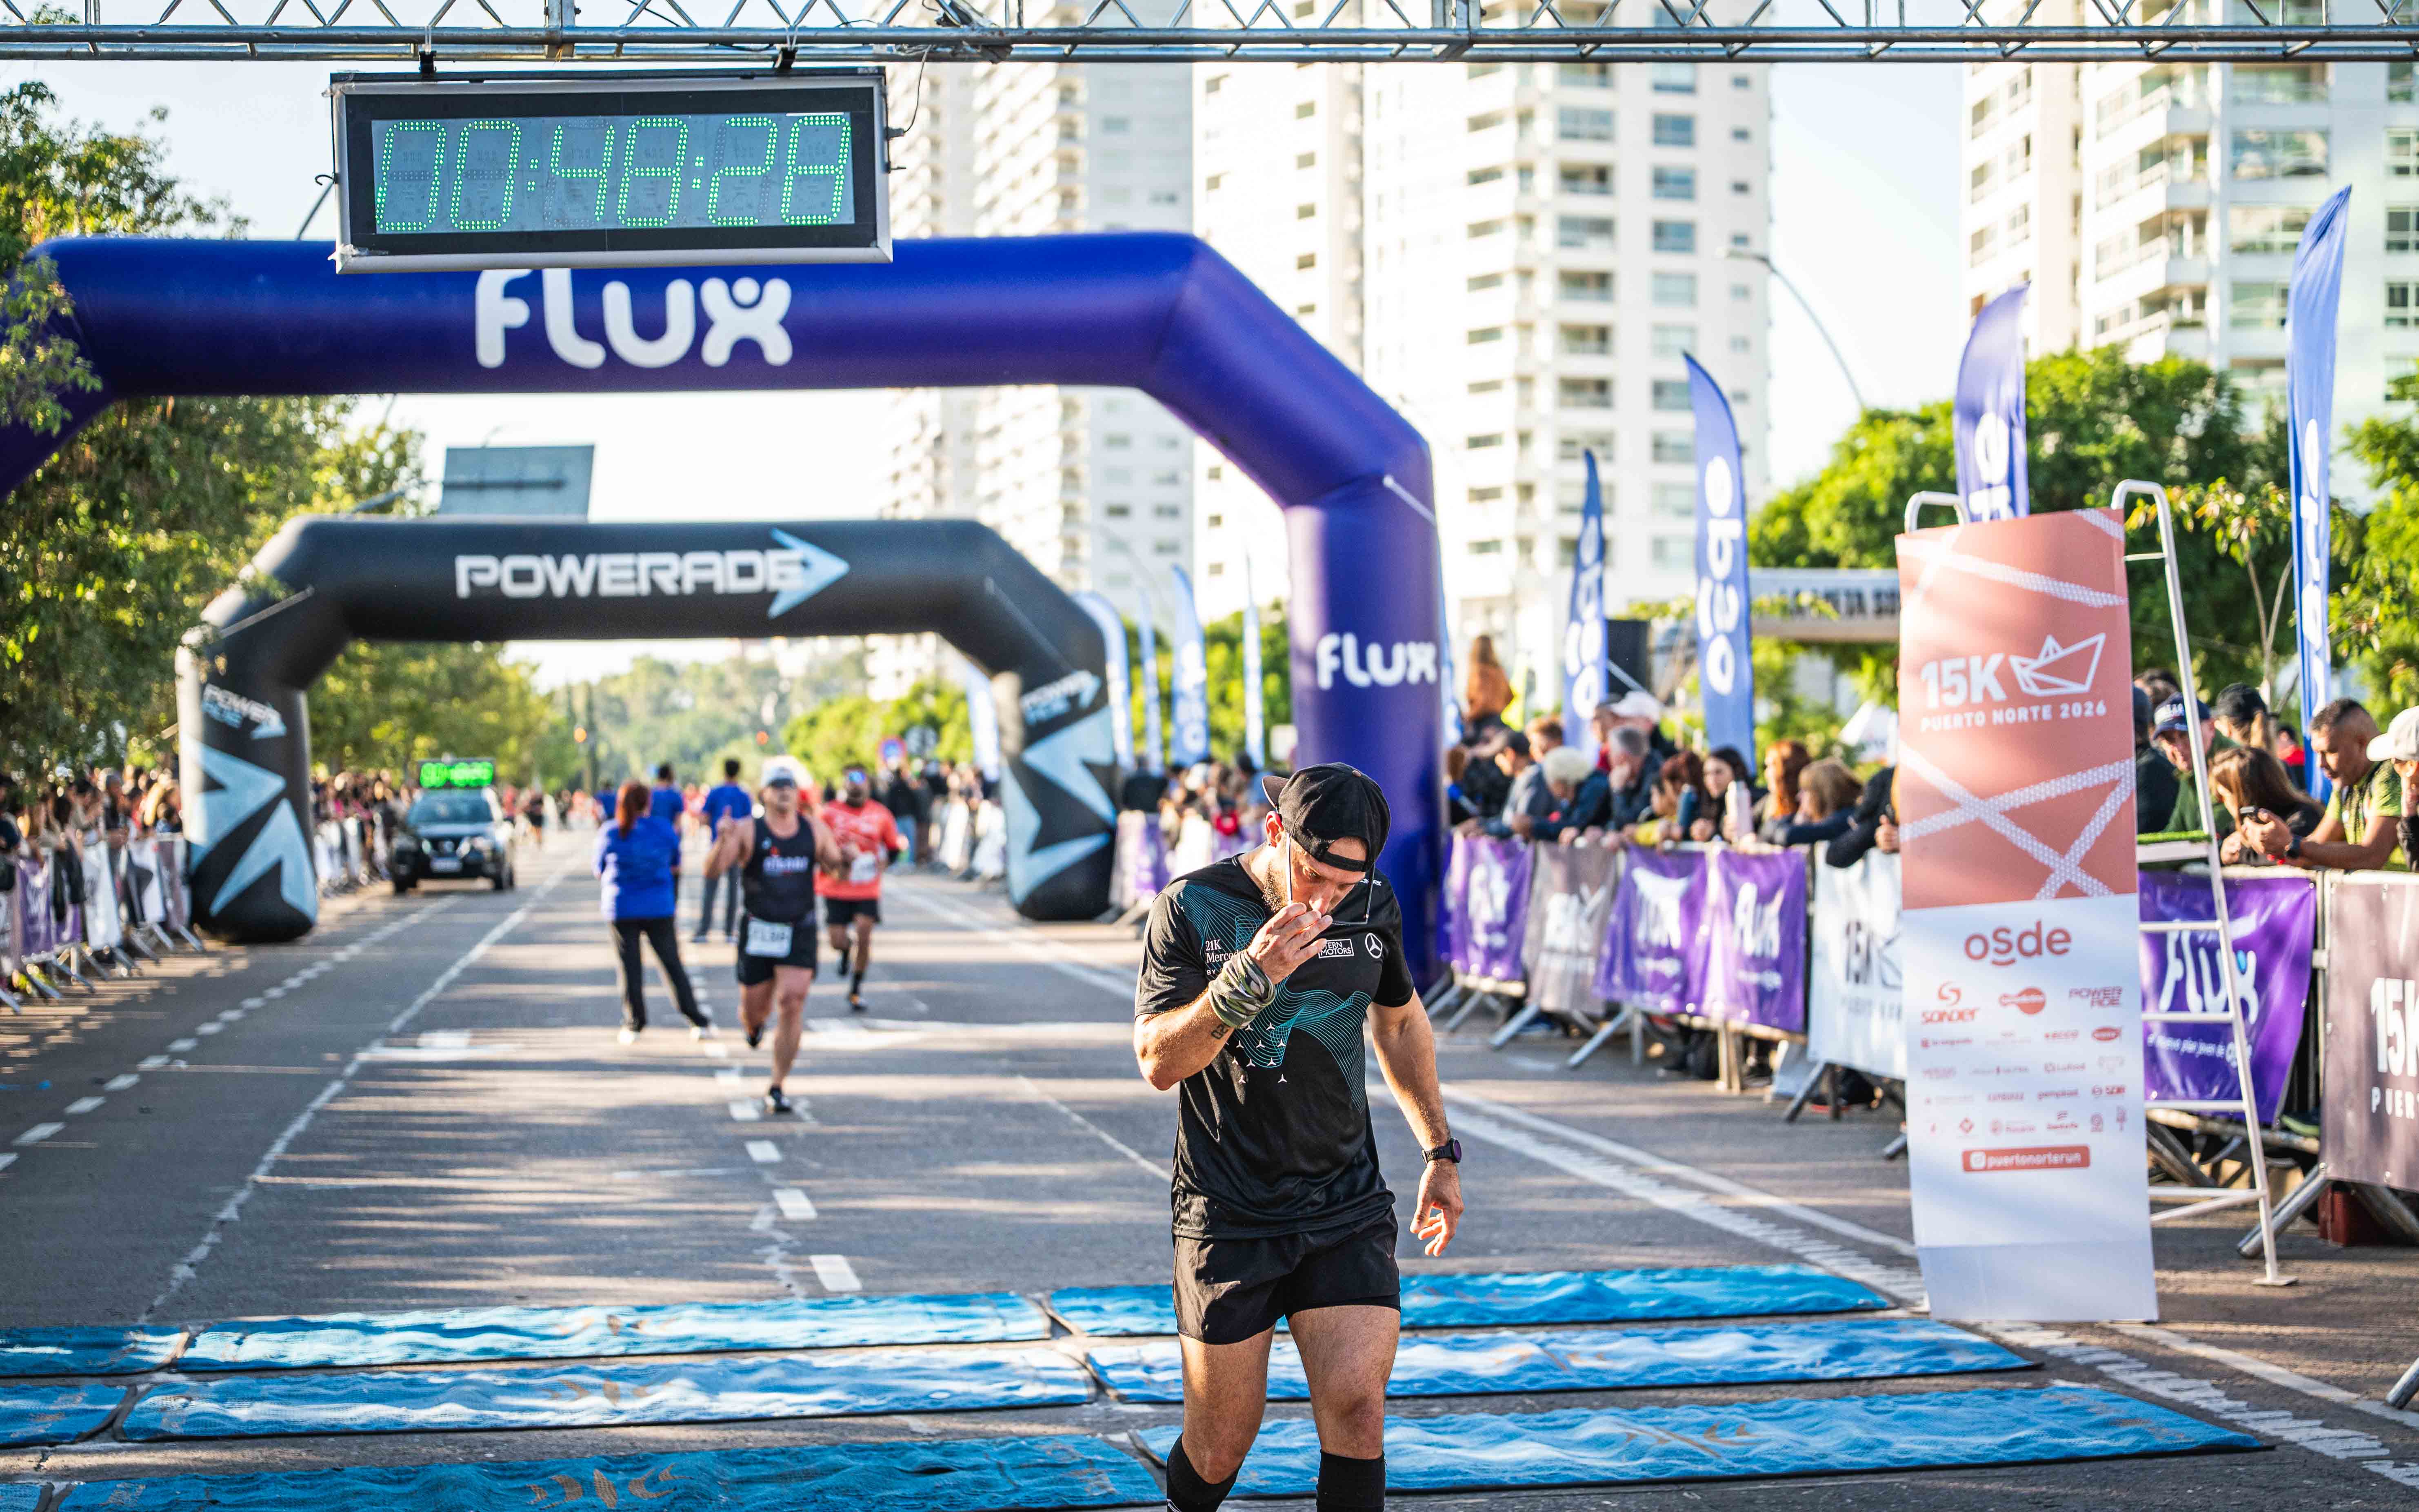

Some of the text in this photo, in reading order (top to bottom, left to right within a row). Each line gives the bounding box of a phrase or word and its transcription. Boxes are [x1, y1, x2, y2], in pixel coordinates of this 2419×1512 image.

[375, 116, 852, 232] 00:48:28
[455, 548, 808, 599] POWERADE
[1920, 653, 2008, 710] 15K
[1919, 699, 2107, 733] PUERTO NORTE 2026
[1205, 939, 1222, 951] 21K
[1320, 947, 1352, 956] MOTORS
[1964, 920, 2072, 965] osde
[2370, 1086, 2419, 1120] PUER
[1987, 1151, 2081, 1169] puertonorterun
